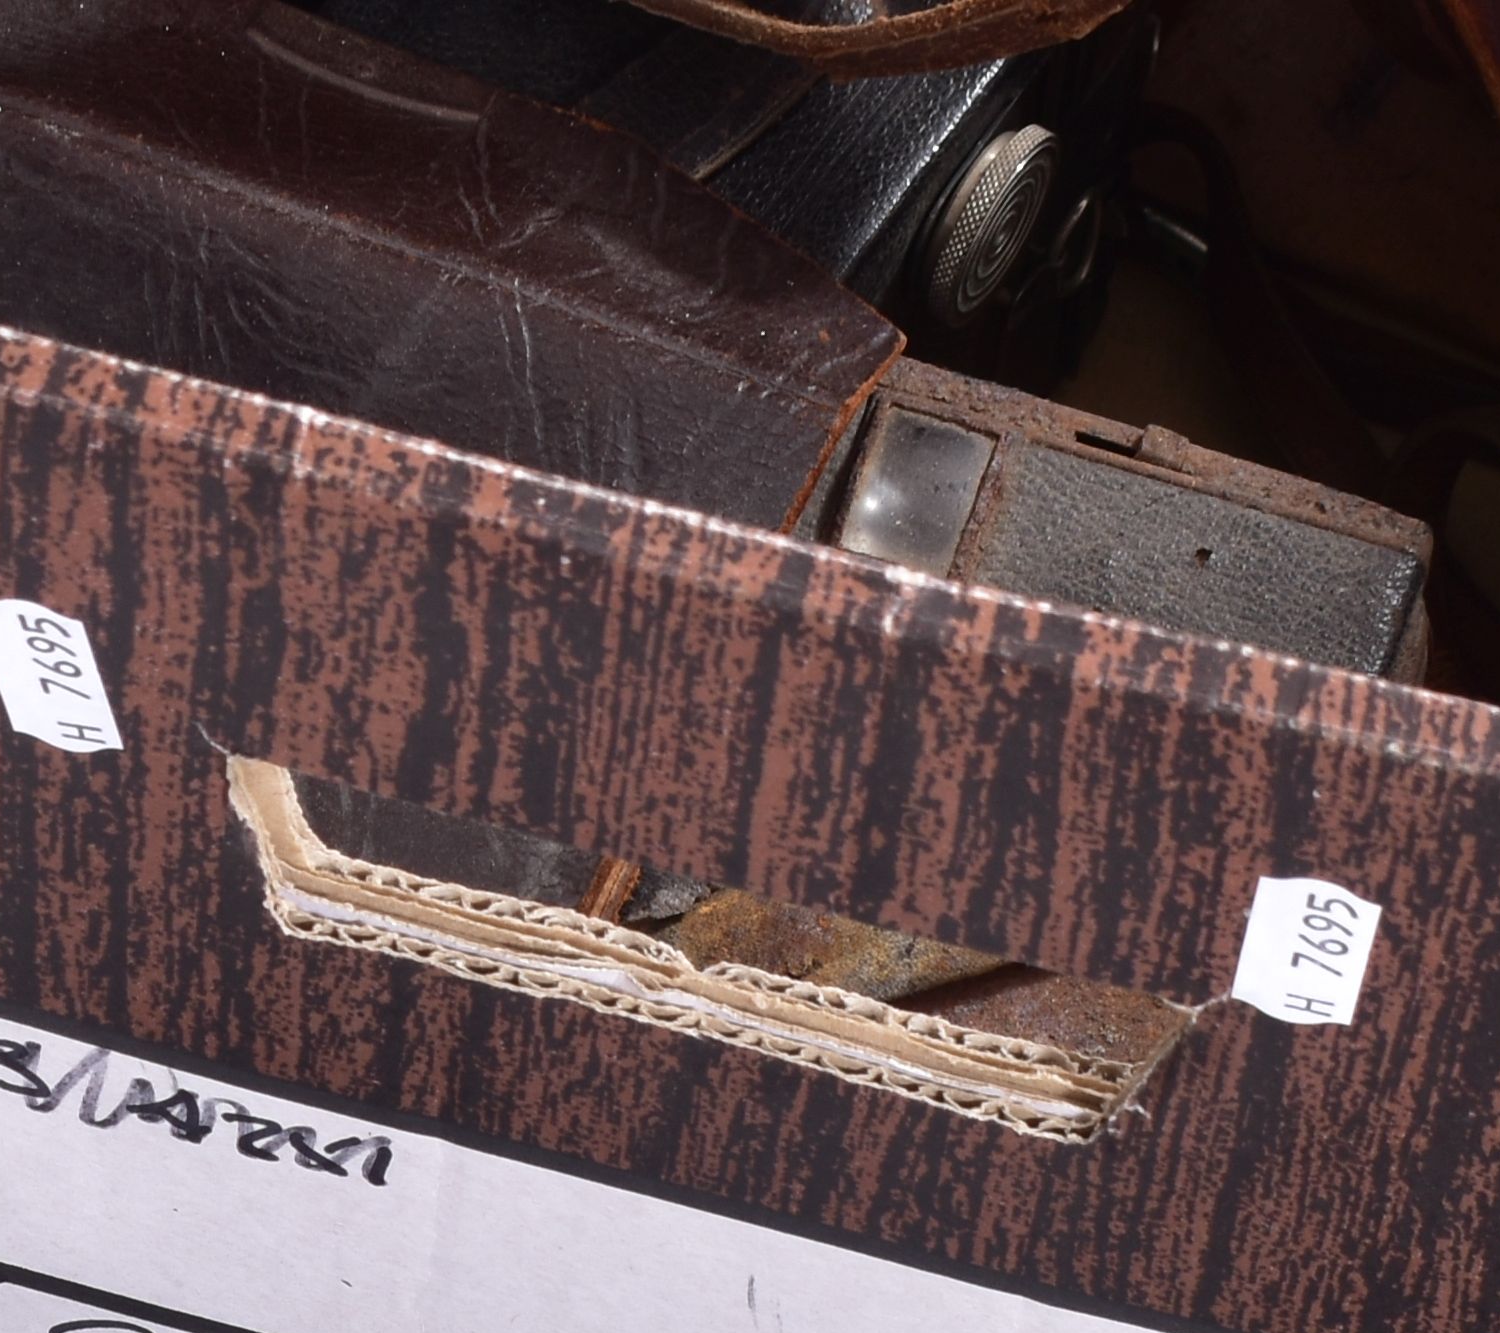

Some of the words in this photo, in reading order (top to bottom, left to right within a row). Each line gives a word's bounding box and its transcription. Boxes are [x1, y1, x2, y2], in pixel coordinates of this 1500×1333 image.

[17, 613, 92, 700] 7695
[58, 720, 107, 745] H
[1290, 892, 1359, 978] 7695
[1283, 992, 1335, 1018] H
